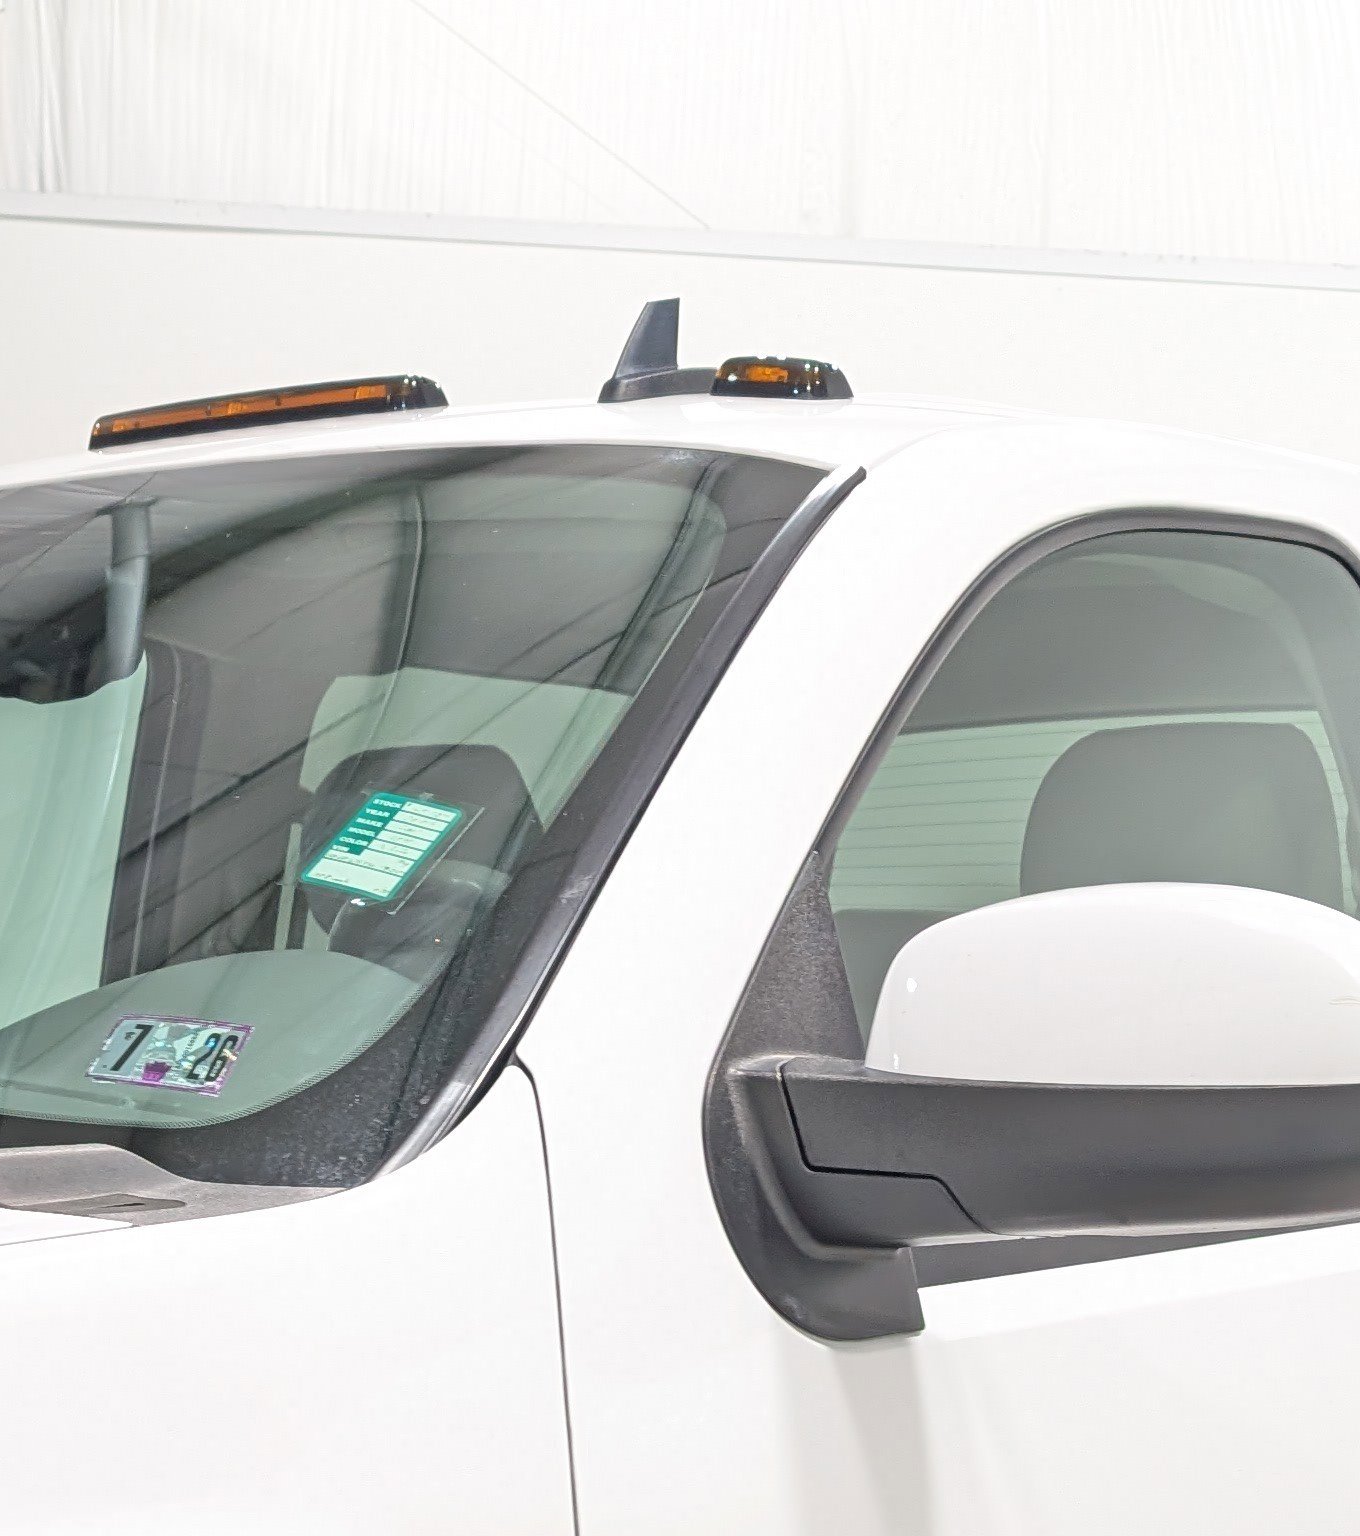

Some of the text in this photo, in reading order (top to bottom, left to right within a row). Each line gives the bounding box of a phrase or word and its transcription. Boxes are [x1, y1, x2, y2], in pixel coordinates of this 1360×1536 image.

[365, 808, 391, 818] YEAR
[110, 1023, 154, 1072] 7
[186, 1032, 240, 1083] 26
